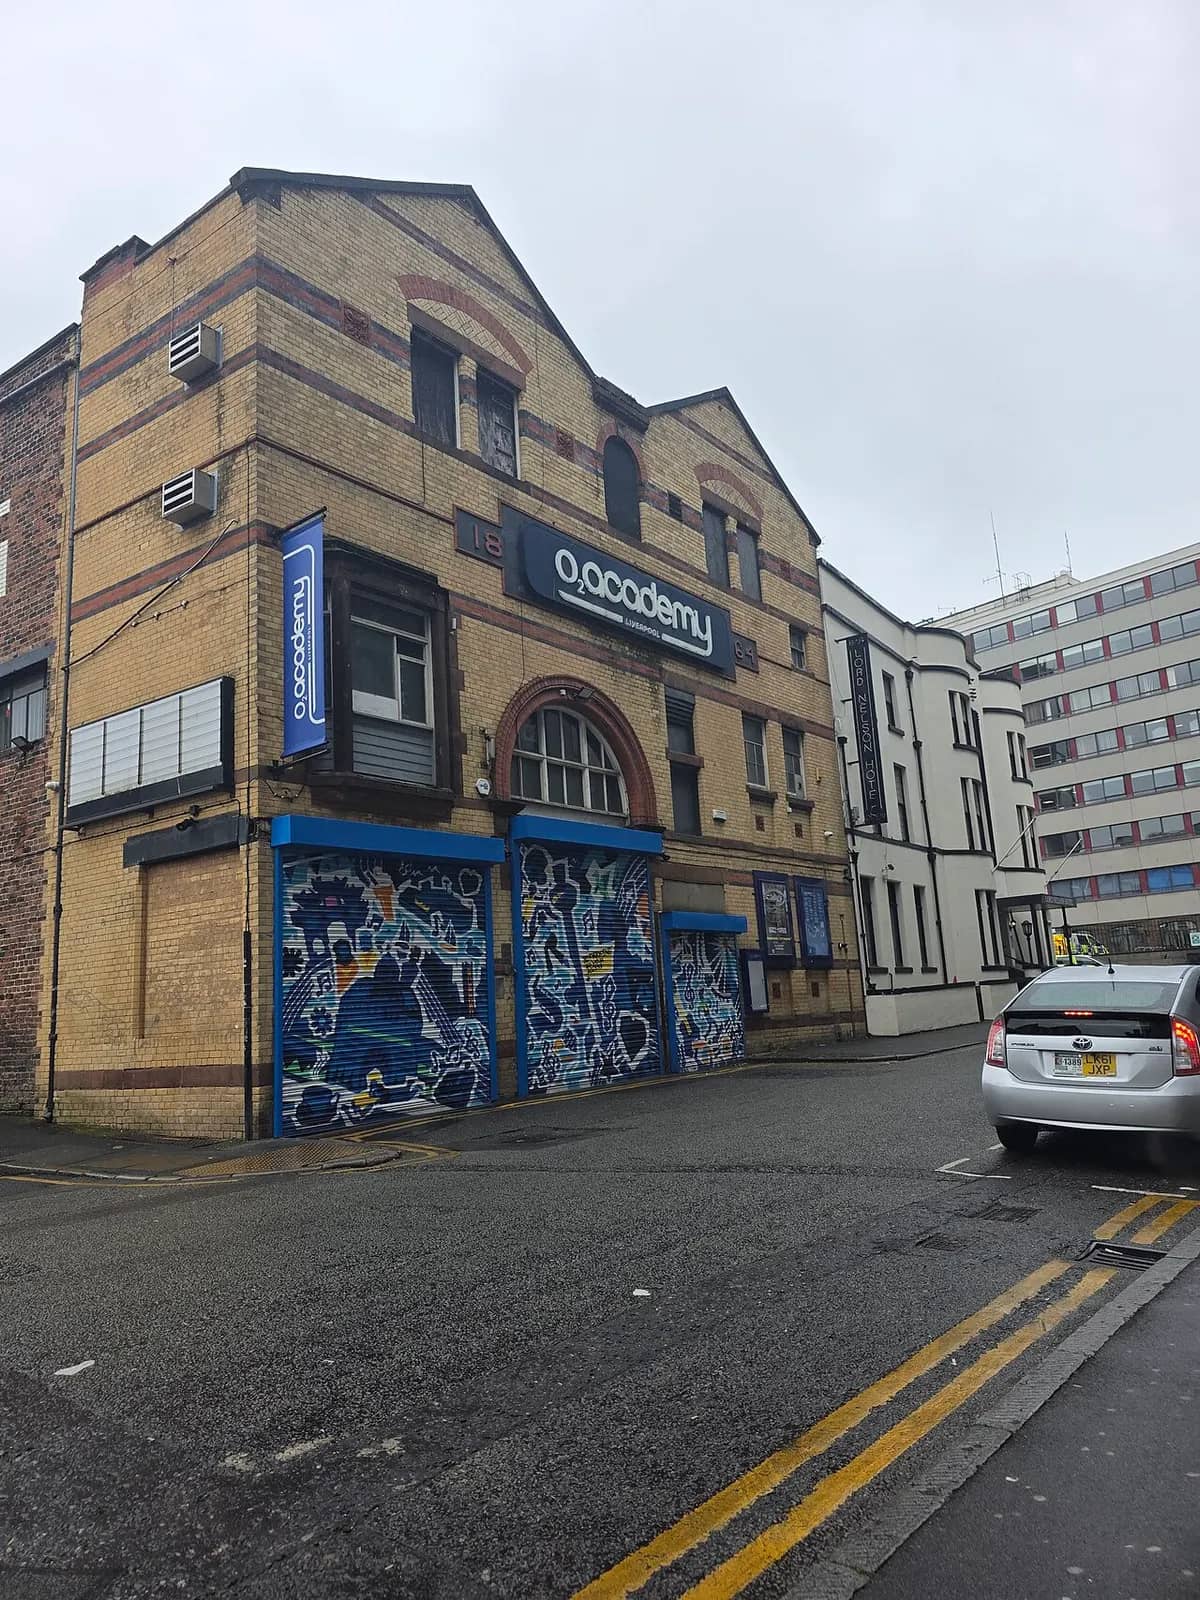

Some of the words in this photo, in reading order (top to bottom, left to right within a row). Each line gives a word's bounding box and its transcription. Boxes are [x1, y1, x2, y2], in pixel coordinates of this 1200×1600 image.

[474, 524, 503, 557] 18
[624, 617, 661, 639] LIVERPOOL
[853, 650, 865, 687] LORD
[857, 694, 873, 753] NELSON
[1085, 1054, 1112, 1065] LK61
[1088, 1064, 1111, 1075] JXP
